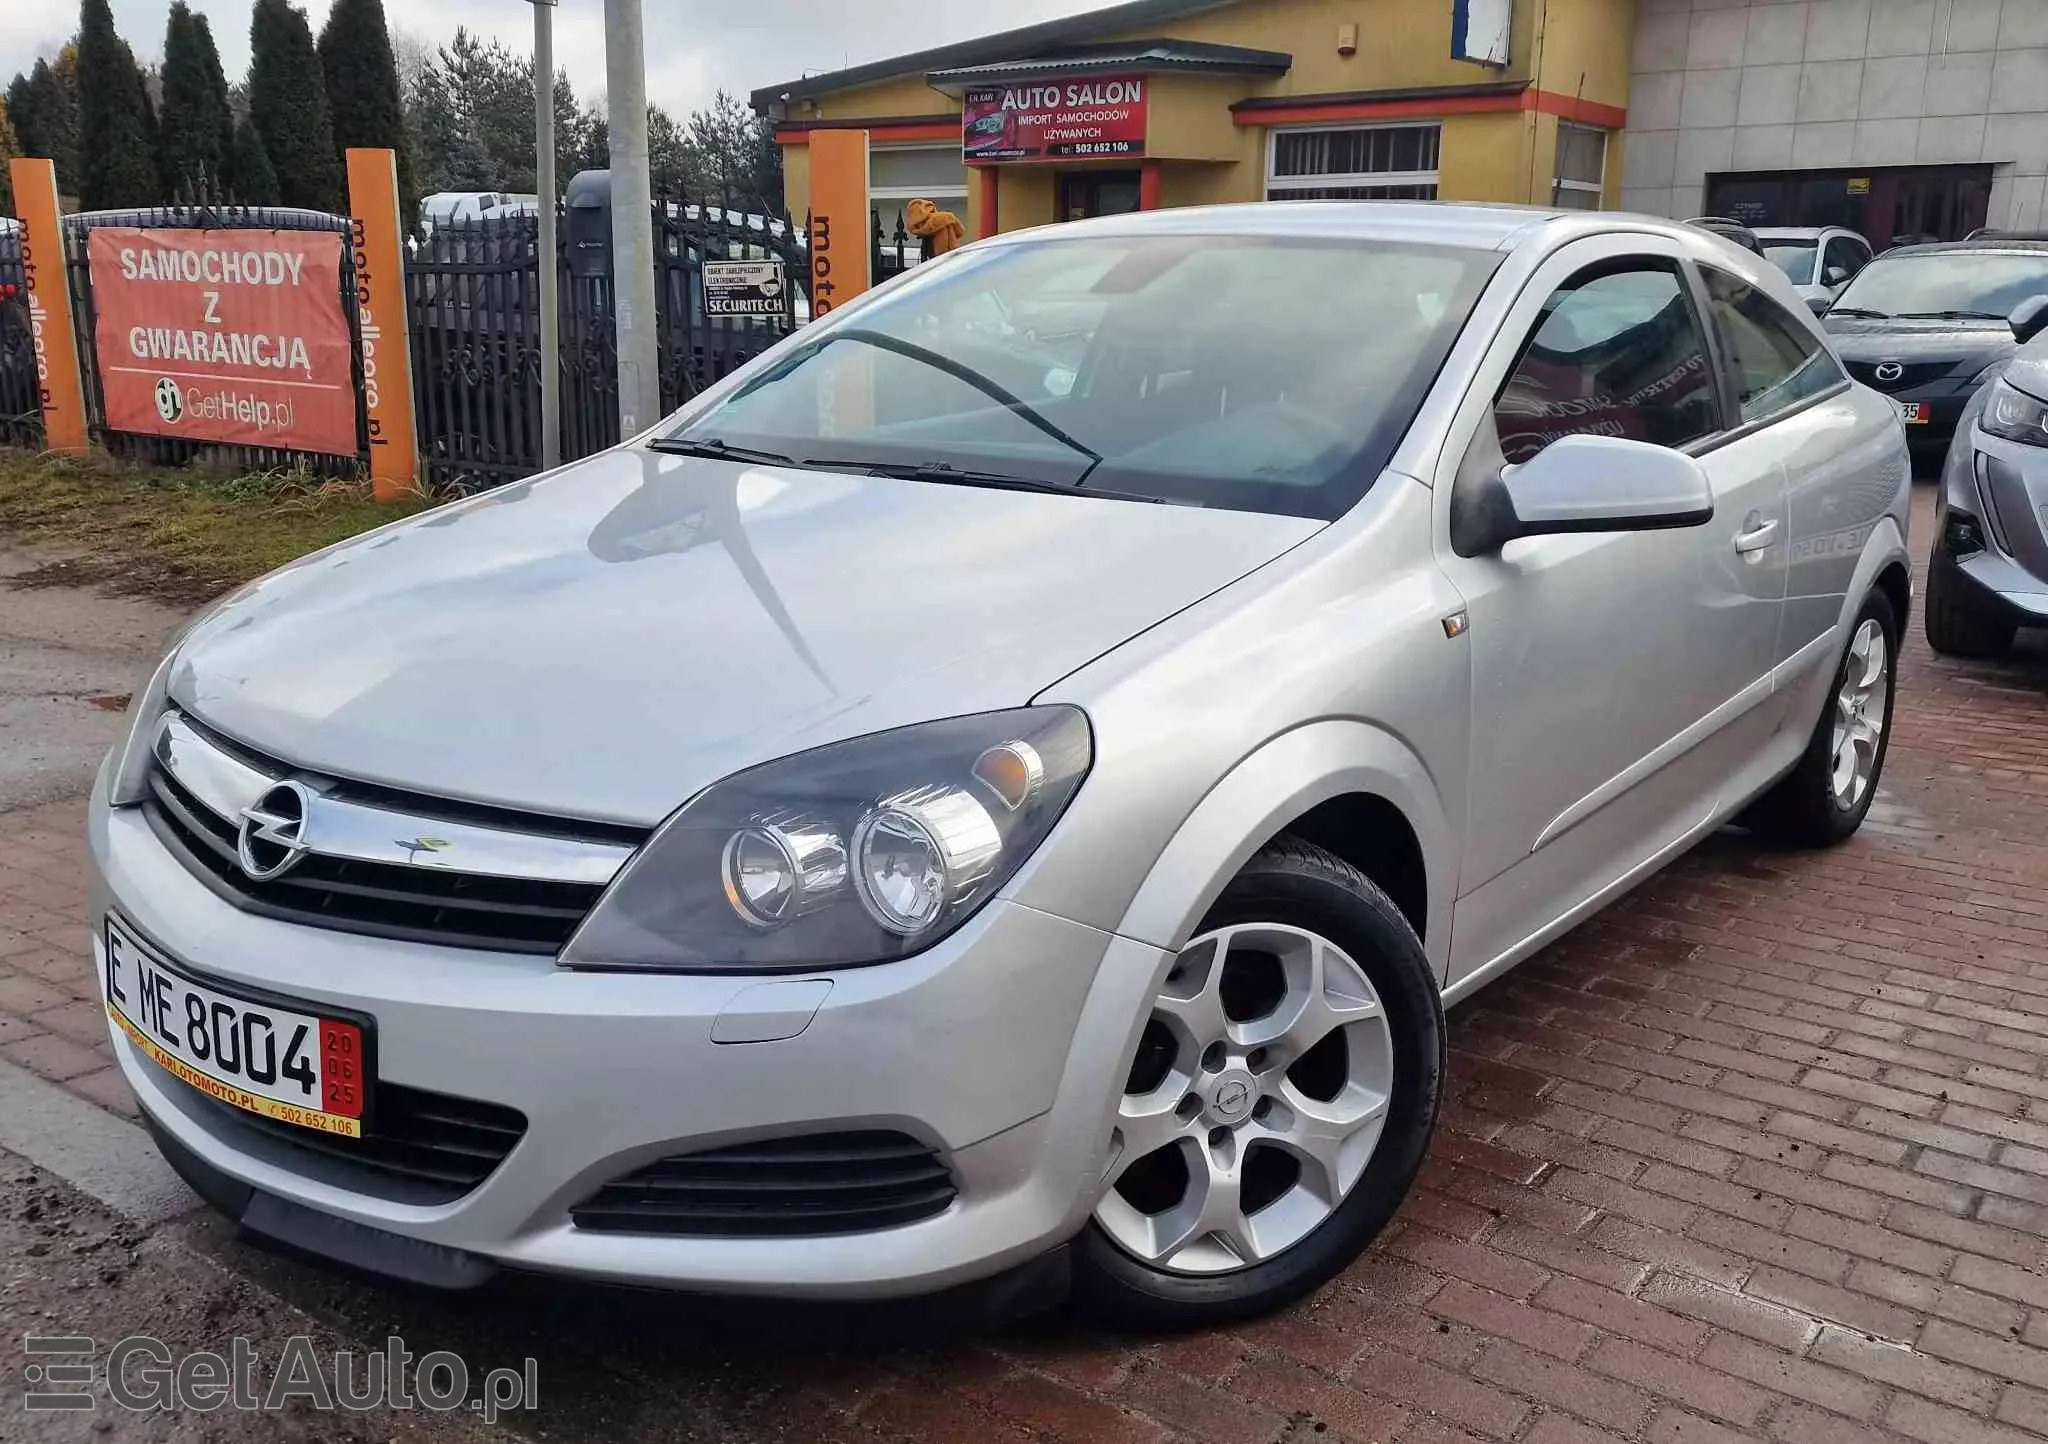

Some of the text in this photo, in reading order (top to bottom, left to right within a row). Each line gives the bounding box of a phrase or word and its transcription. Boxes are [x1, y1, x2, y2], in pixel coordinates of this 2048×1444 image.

[1002, 81, 1141, 111] AUTO SALON
[1018, 113, 1053, 126] IMPORT
[1043, 127, 1102, 140] UŻYWANYCH
[1075, 143, 1092, 154] 502
[1094, 142, 1110, 152] 652
[1112, 141, 1129, 152] 106
[120, 248, 305, 286] SAMOCHODY
[813, 216, 836, 319] moto
[203, 291, 222, 324] Z
[709, 299, 783, 312] SECURITECH
[129, 326, 312, 380] GWARANCJĄ
[187, 387, 294, 432] GetHelp.pl
[110, 932, 125, 1003] E
[327, 1030, 352, 1054] 20
[328, 1056, 353, 1079] 06
[153, 1048, 259, 1111] KARI.OTOMOTO.PL
[281, 1106, 301, 1123] 502
[305, 1112, 327, 1129] 652
[330, 1117, 353, 1135] 106
[328, 1081, 354, 1104] 25
